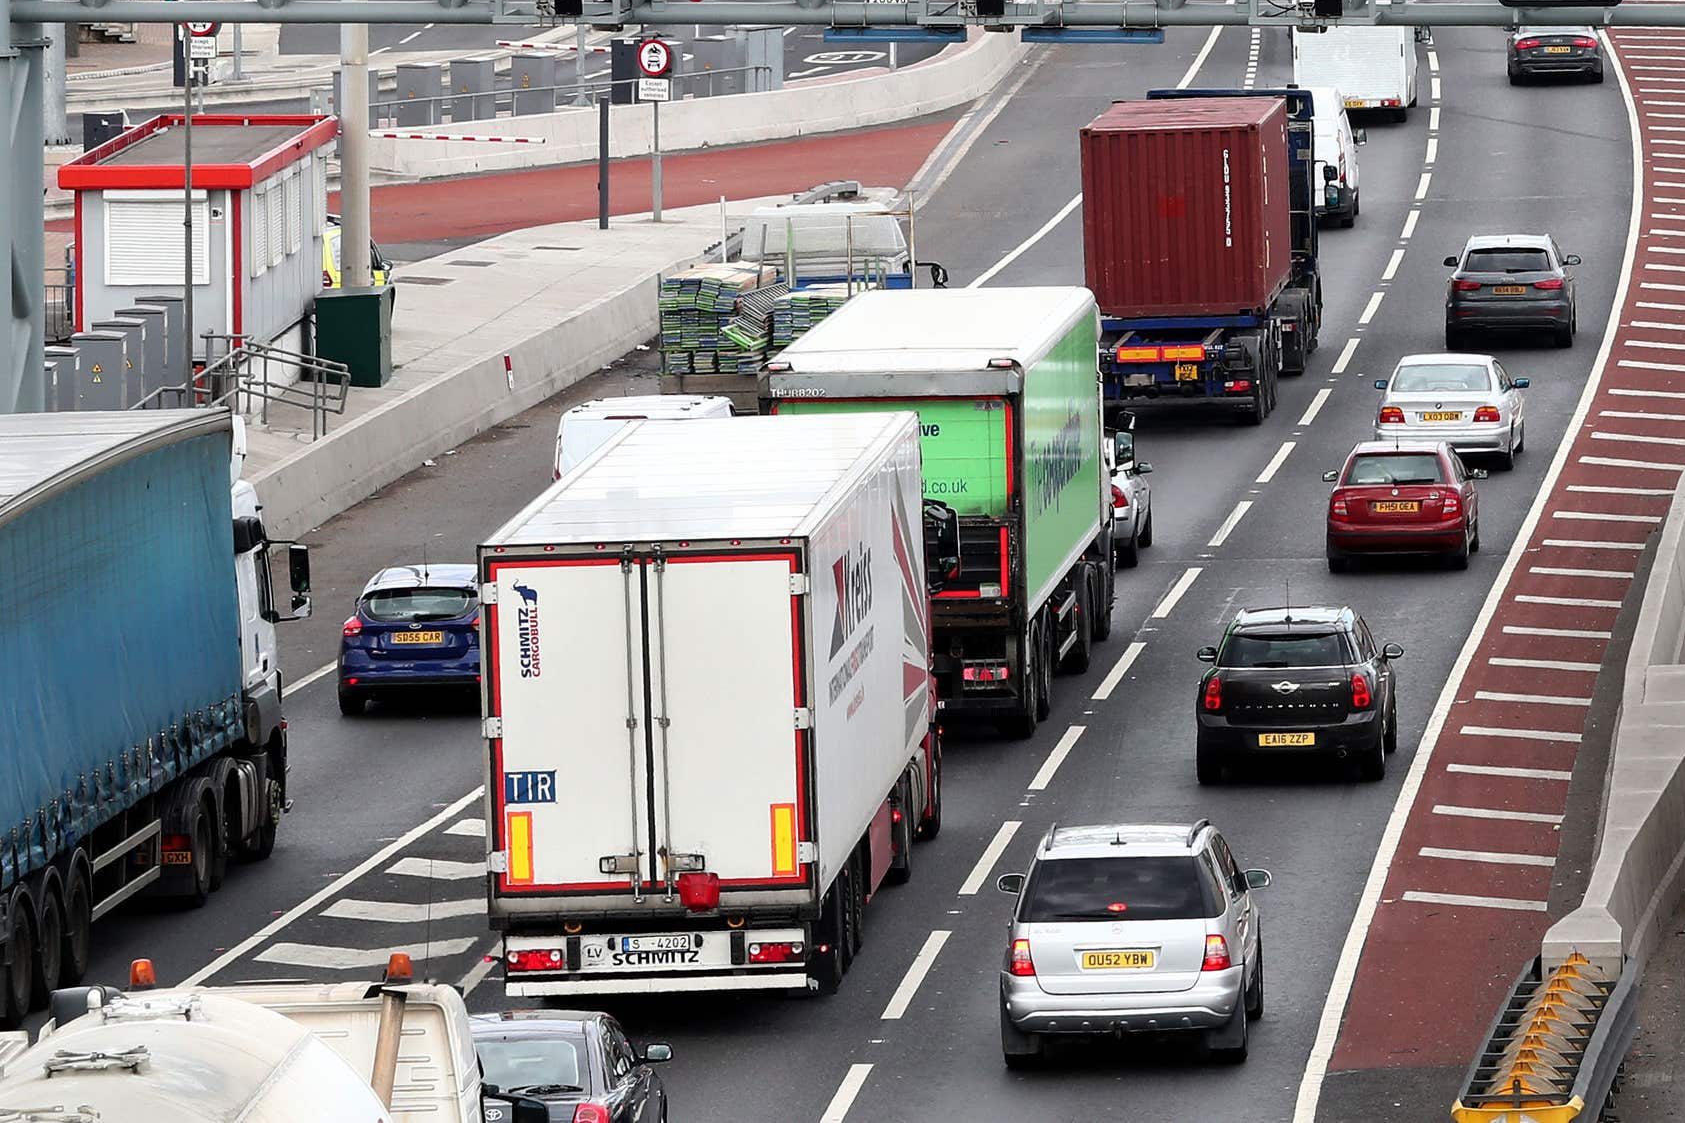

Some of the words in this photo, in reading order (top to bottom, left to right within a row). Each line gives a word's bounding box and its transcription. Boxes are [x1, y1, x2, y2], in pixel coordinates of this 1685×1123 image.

[518, 607, 532, 678] SCHMITZ
[530, 606, 541, 678] CARGOBULL
[1265, 735, 1287, 744] EA16
[1290, 734, 1308, 743] ZZP
[509, 774, 551, 803] TIR
[587, 948, 602, 958] LV
[612, 951, 699, 966] SCHMITZ
[1088, 954, 1120, 966] OU52
[1123, 953, 1148, 964] YBW
